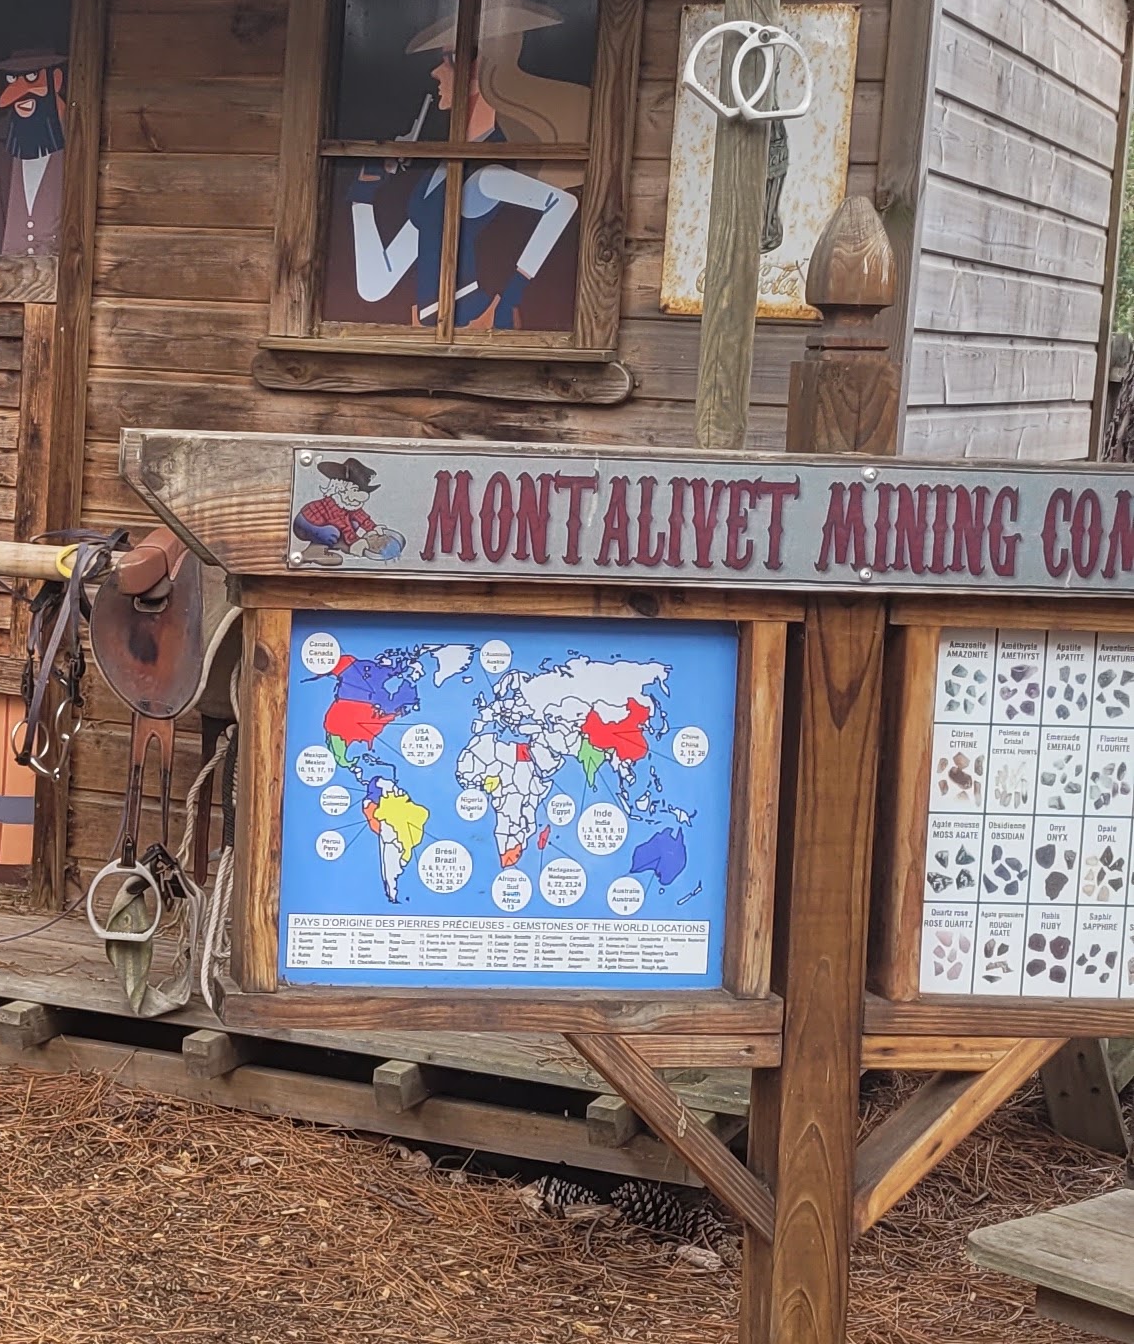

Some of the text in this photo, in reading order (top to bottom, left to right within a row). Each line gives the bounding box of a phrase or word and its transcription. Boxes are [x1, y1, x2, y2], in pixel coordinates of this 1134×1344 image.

[420, 470, 800, 570] MONTALIVET
[814, 482, 1023, 576] MINING
[949, 641, 987, 649] Amazonite
[1056, 643, 1082, 652] Apatite
[946, 651, 989, 659] AMAZONITE
[1001, 652, 1040, 660] AMETHYST
[1055, 654, 1085, 662] APATITE
[951, 730, 974, 738] Citrine
[949, 740, 978, 749] CITRINE
[1003, 737, 1024, 745] Cristal
[1046, 743, 1081, 752] EMERALD
[1096, 744, 1130, 753] FLOURITE
[593, 809, 612, 817] Inde
[932, 820, 952, 829] Agate
[1049, 823, 1066, 832] Onyx
[1097, 824, 1117, 833] Opale
[932, 831, 979, 840] MOSS AGATE
[991, 832, 1025, 840] OBSIDIAN
[1046, 833, 1068, 842] ONYX
[1097, 834, 1117, 843] OPAL
[931, 908, 952, 917] Quartz
[1089, 913, 1112, 921] Saphir
[294, 917, 320, 927] PAYS
[322, 918, 373, 928] D'ORIGINE
[375, 919, 395, 928] DES
[397, 920, 440, 928] PIERRES
[442, 920, 505, 930] PRÉCIEUSES
[512, 922, 574, 931] GEMSTONES
[576, 923, 589, 931] OF
[593, 923, 611, 931] THE
[613, 923, 649, 932] WORLD
[651, 924, 706, 933] LOCATIONS
[924, 920, 973, 928] ROSE QUARTZ
[989, 921, 1012, 929] ROUGH
[1040, 922, 1061, 930] RUBY
[1082, 923, 1118, 931] SAPPHIRE
[989, 929, 1011, 937] AGATE
